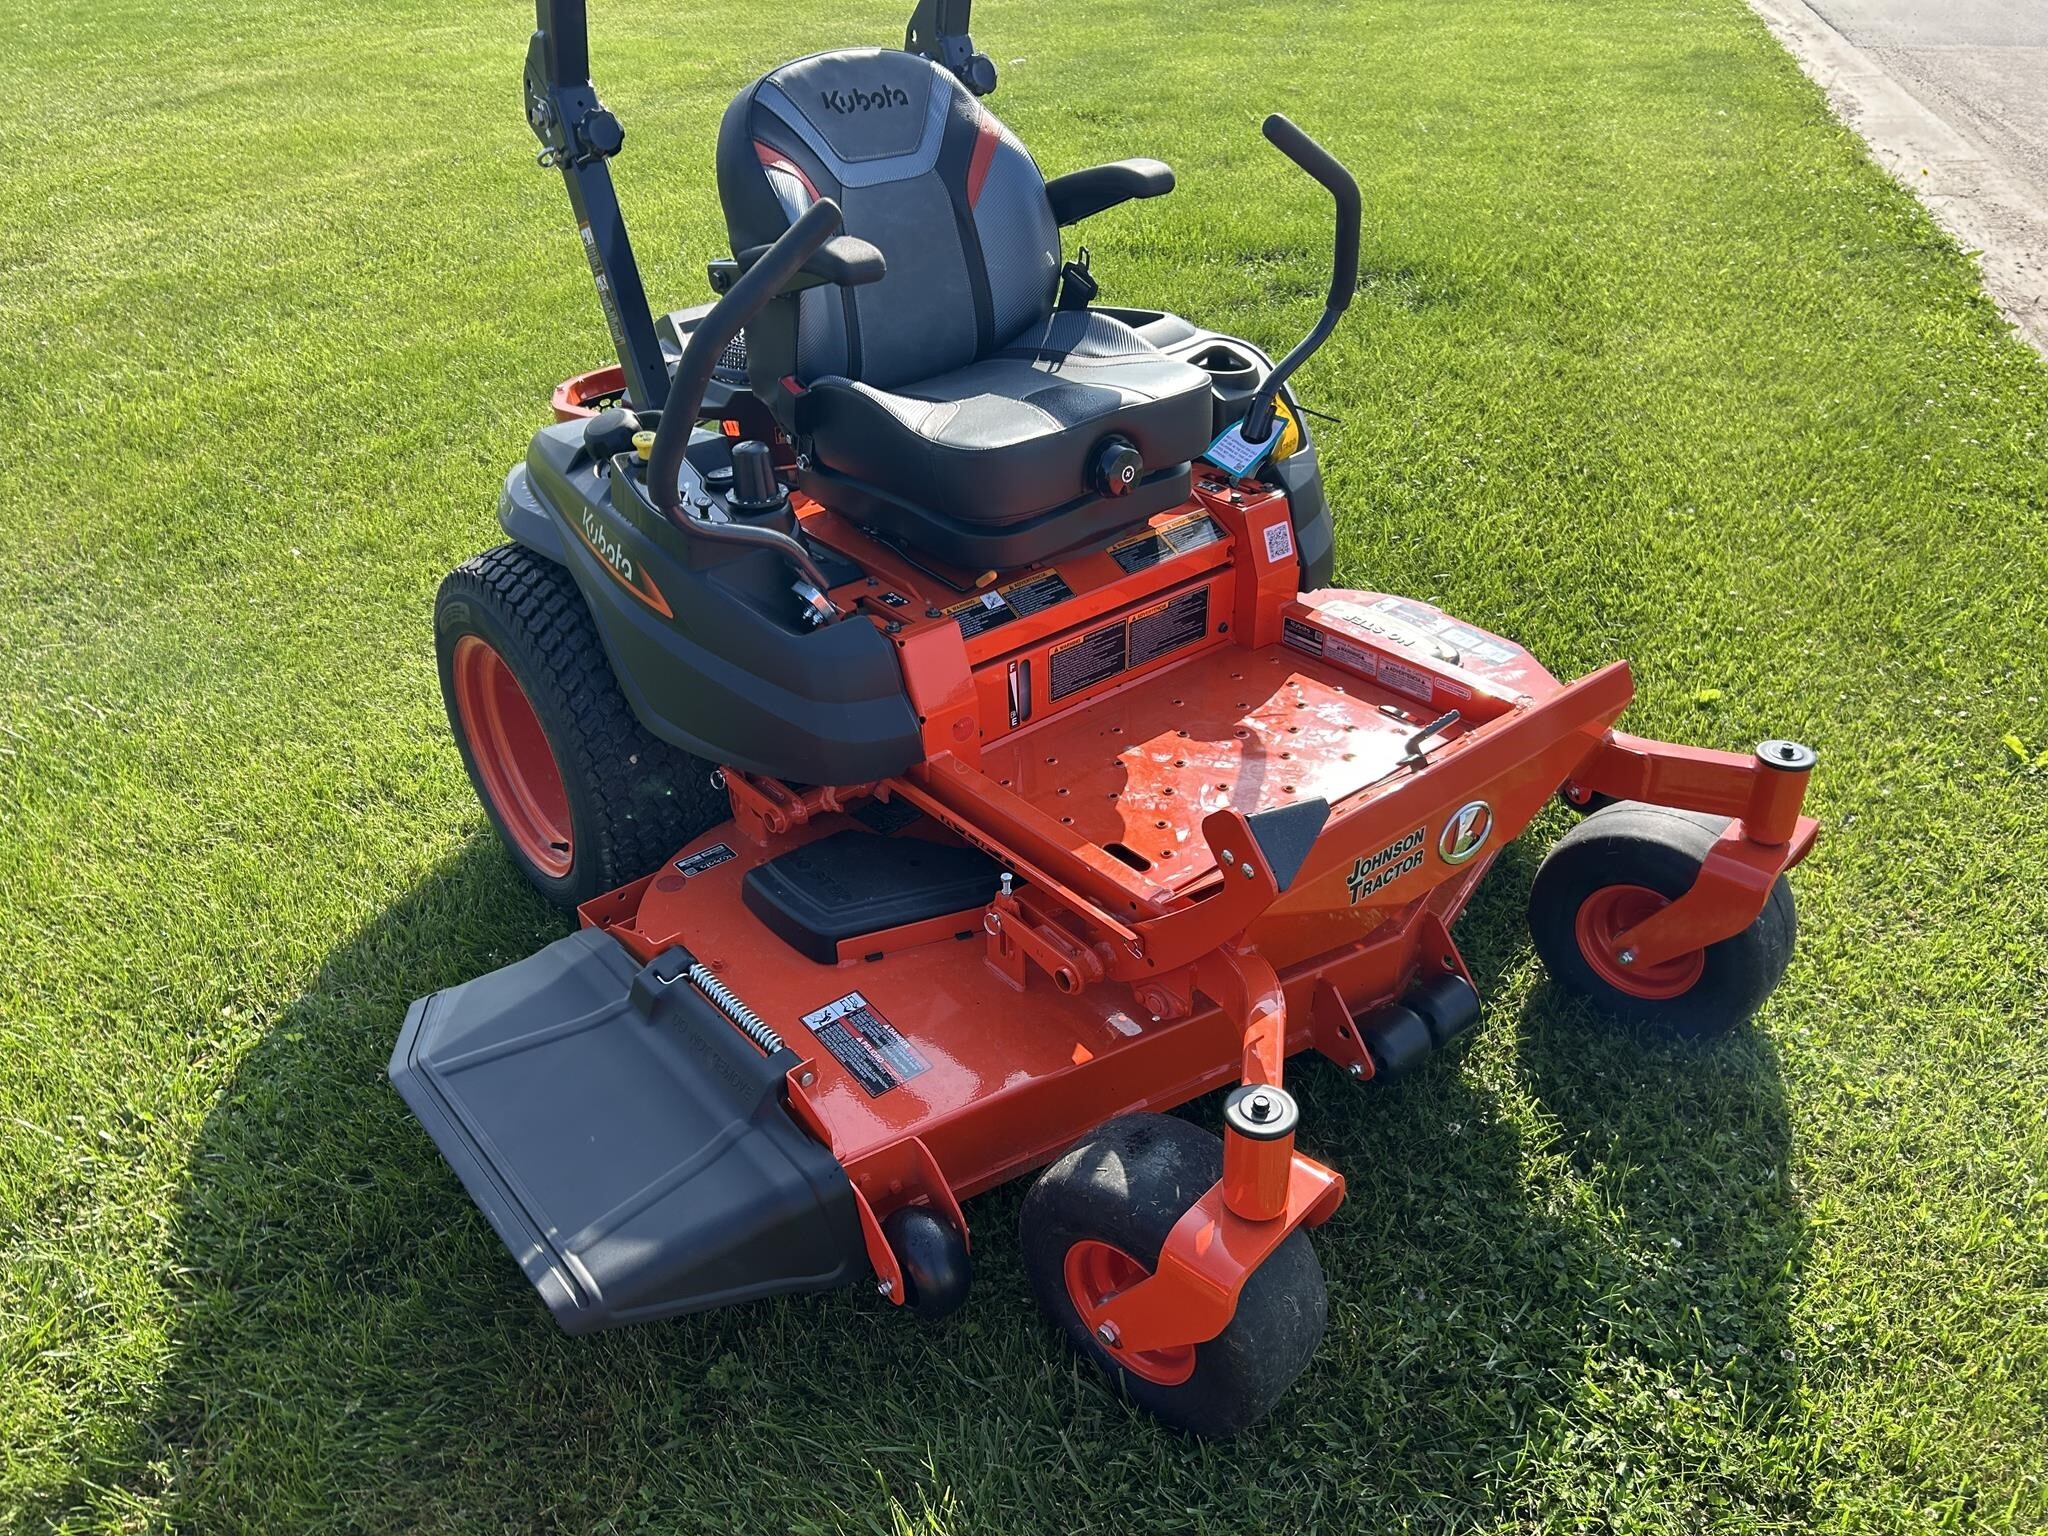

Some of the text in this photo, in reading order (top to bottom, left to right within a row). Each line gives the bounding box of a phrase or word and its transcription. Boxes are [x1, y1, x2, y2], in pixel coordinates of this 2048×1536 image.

[821, 84, 909, 114] Kubota
[582, 506, 632, 581] Kubota
[1009, 662, 1016, 672] F
[1011, 717, 1018, 726] E
[1346, 827, 1425, 885] JOHNSON
[1349, 850, 1424, 904] TRACTOR
[887, 1026, 911, 1050] DANGER
[861, 1041, 885, 1063] PELIGRO
